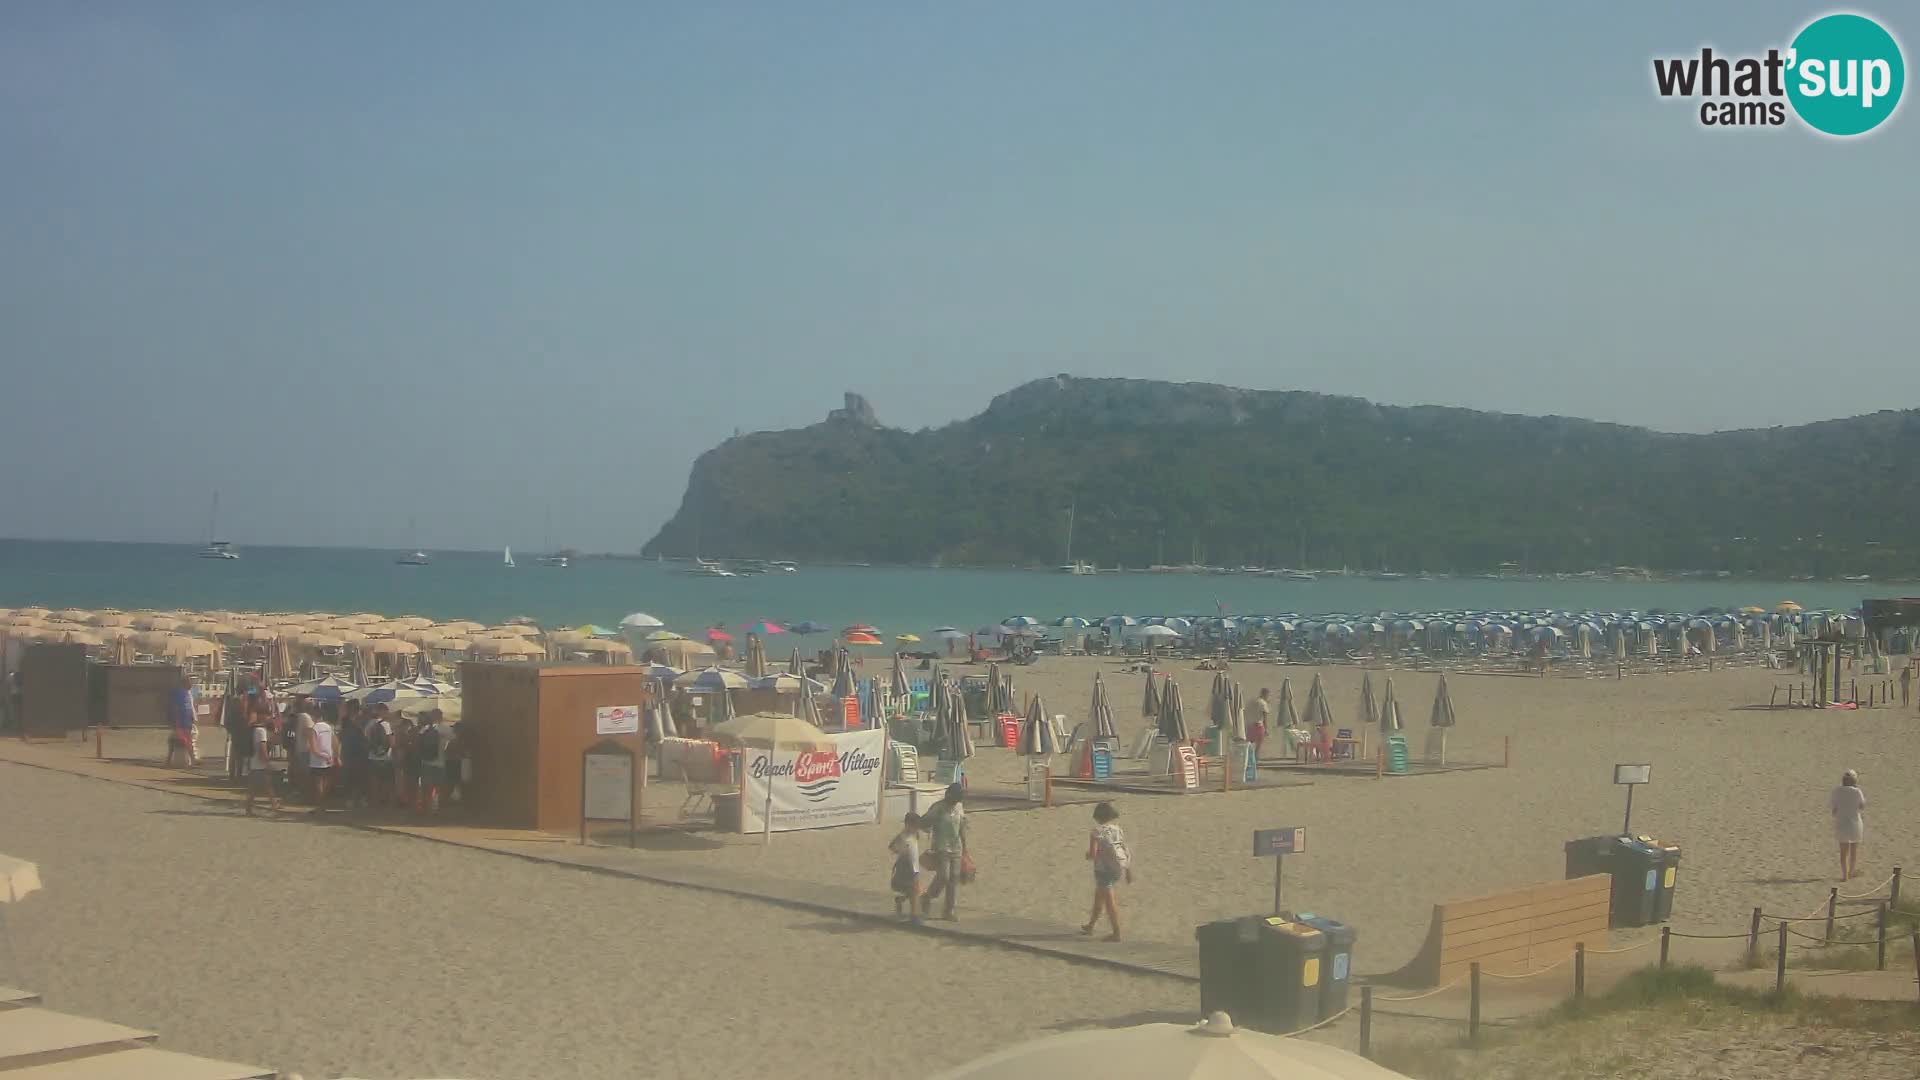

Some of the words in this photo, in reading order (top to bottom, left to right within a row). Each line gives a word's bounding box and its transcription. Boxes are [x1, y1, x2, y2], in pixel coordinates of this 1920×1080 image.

[751, 755, 794, 778] Beach
[797, 752, 836, 779] Sport
[837, 748, 880, 775] Village
